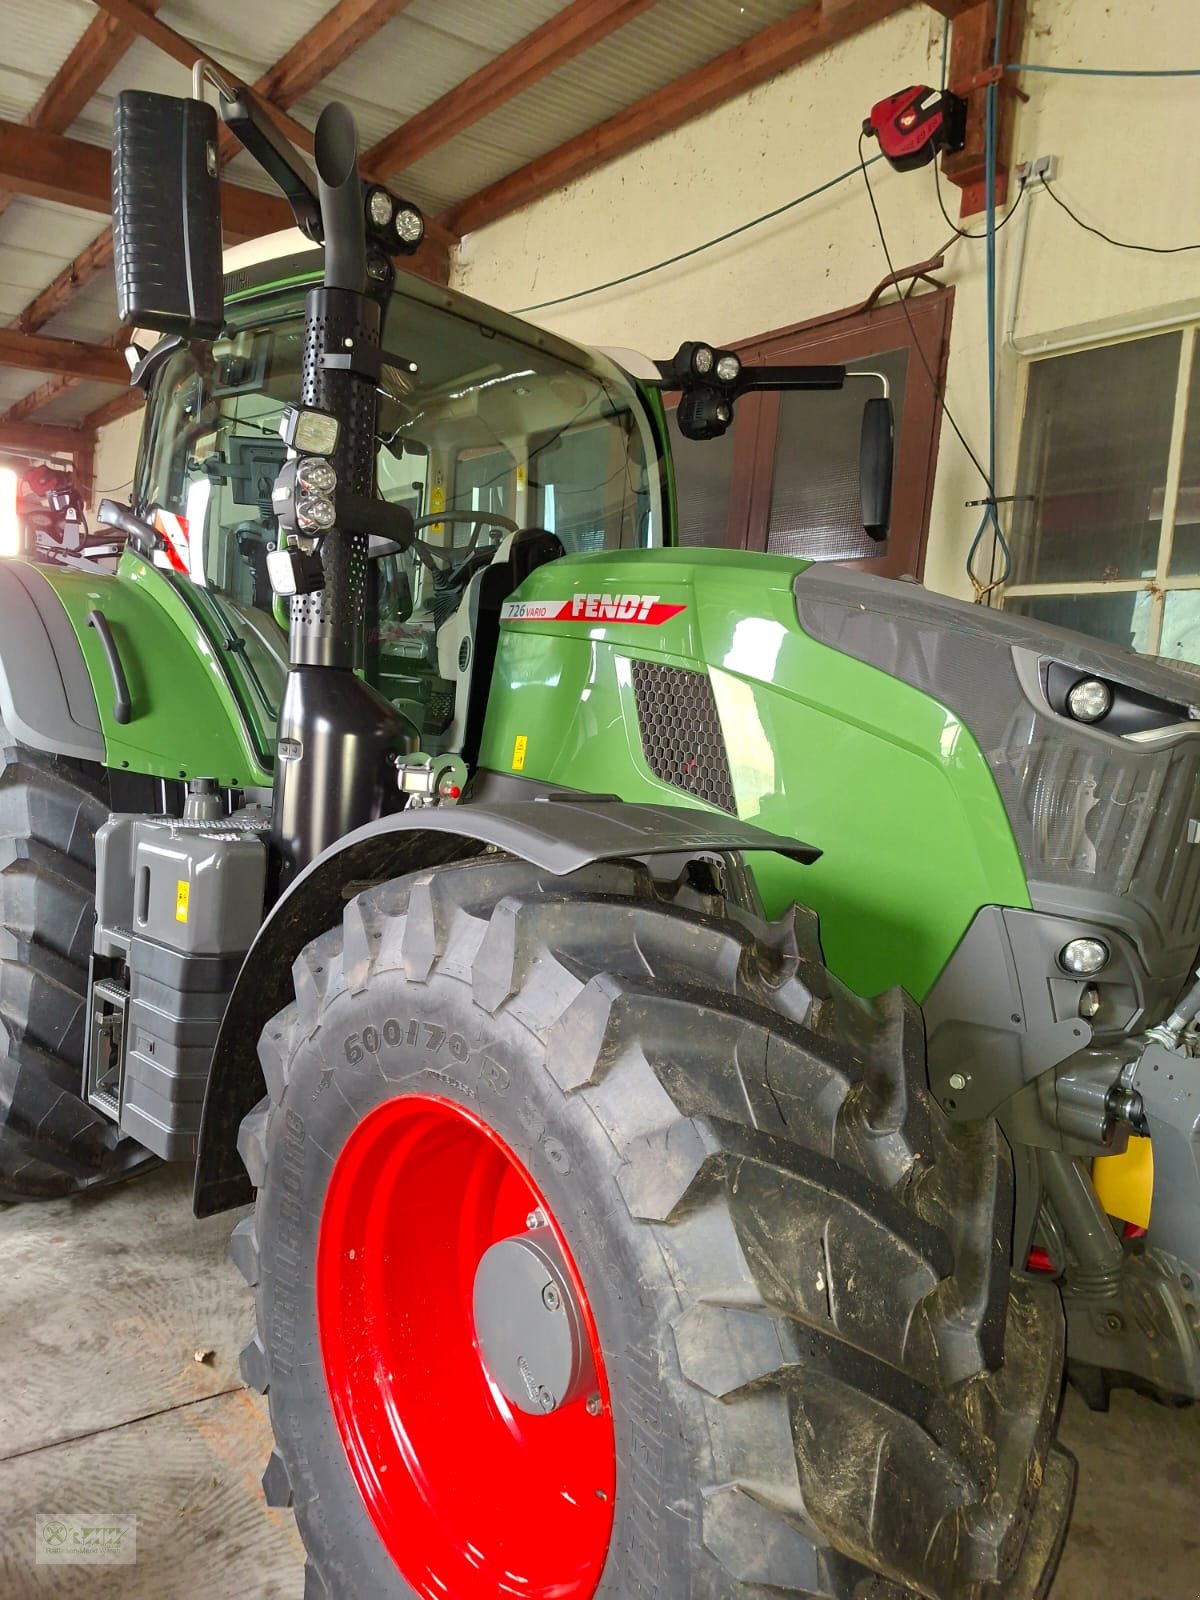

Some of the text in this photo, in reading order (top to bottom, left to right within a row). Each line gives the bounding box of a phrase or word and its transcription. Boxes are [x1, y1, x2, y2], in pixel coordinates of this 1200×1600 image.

[508, 604, 546, 618] 726 VARIO
[572, 593, 661, 620] FENDT
